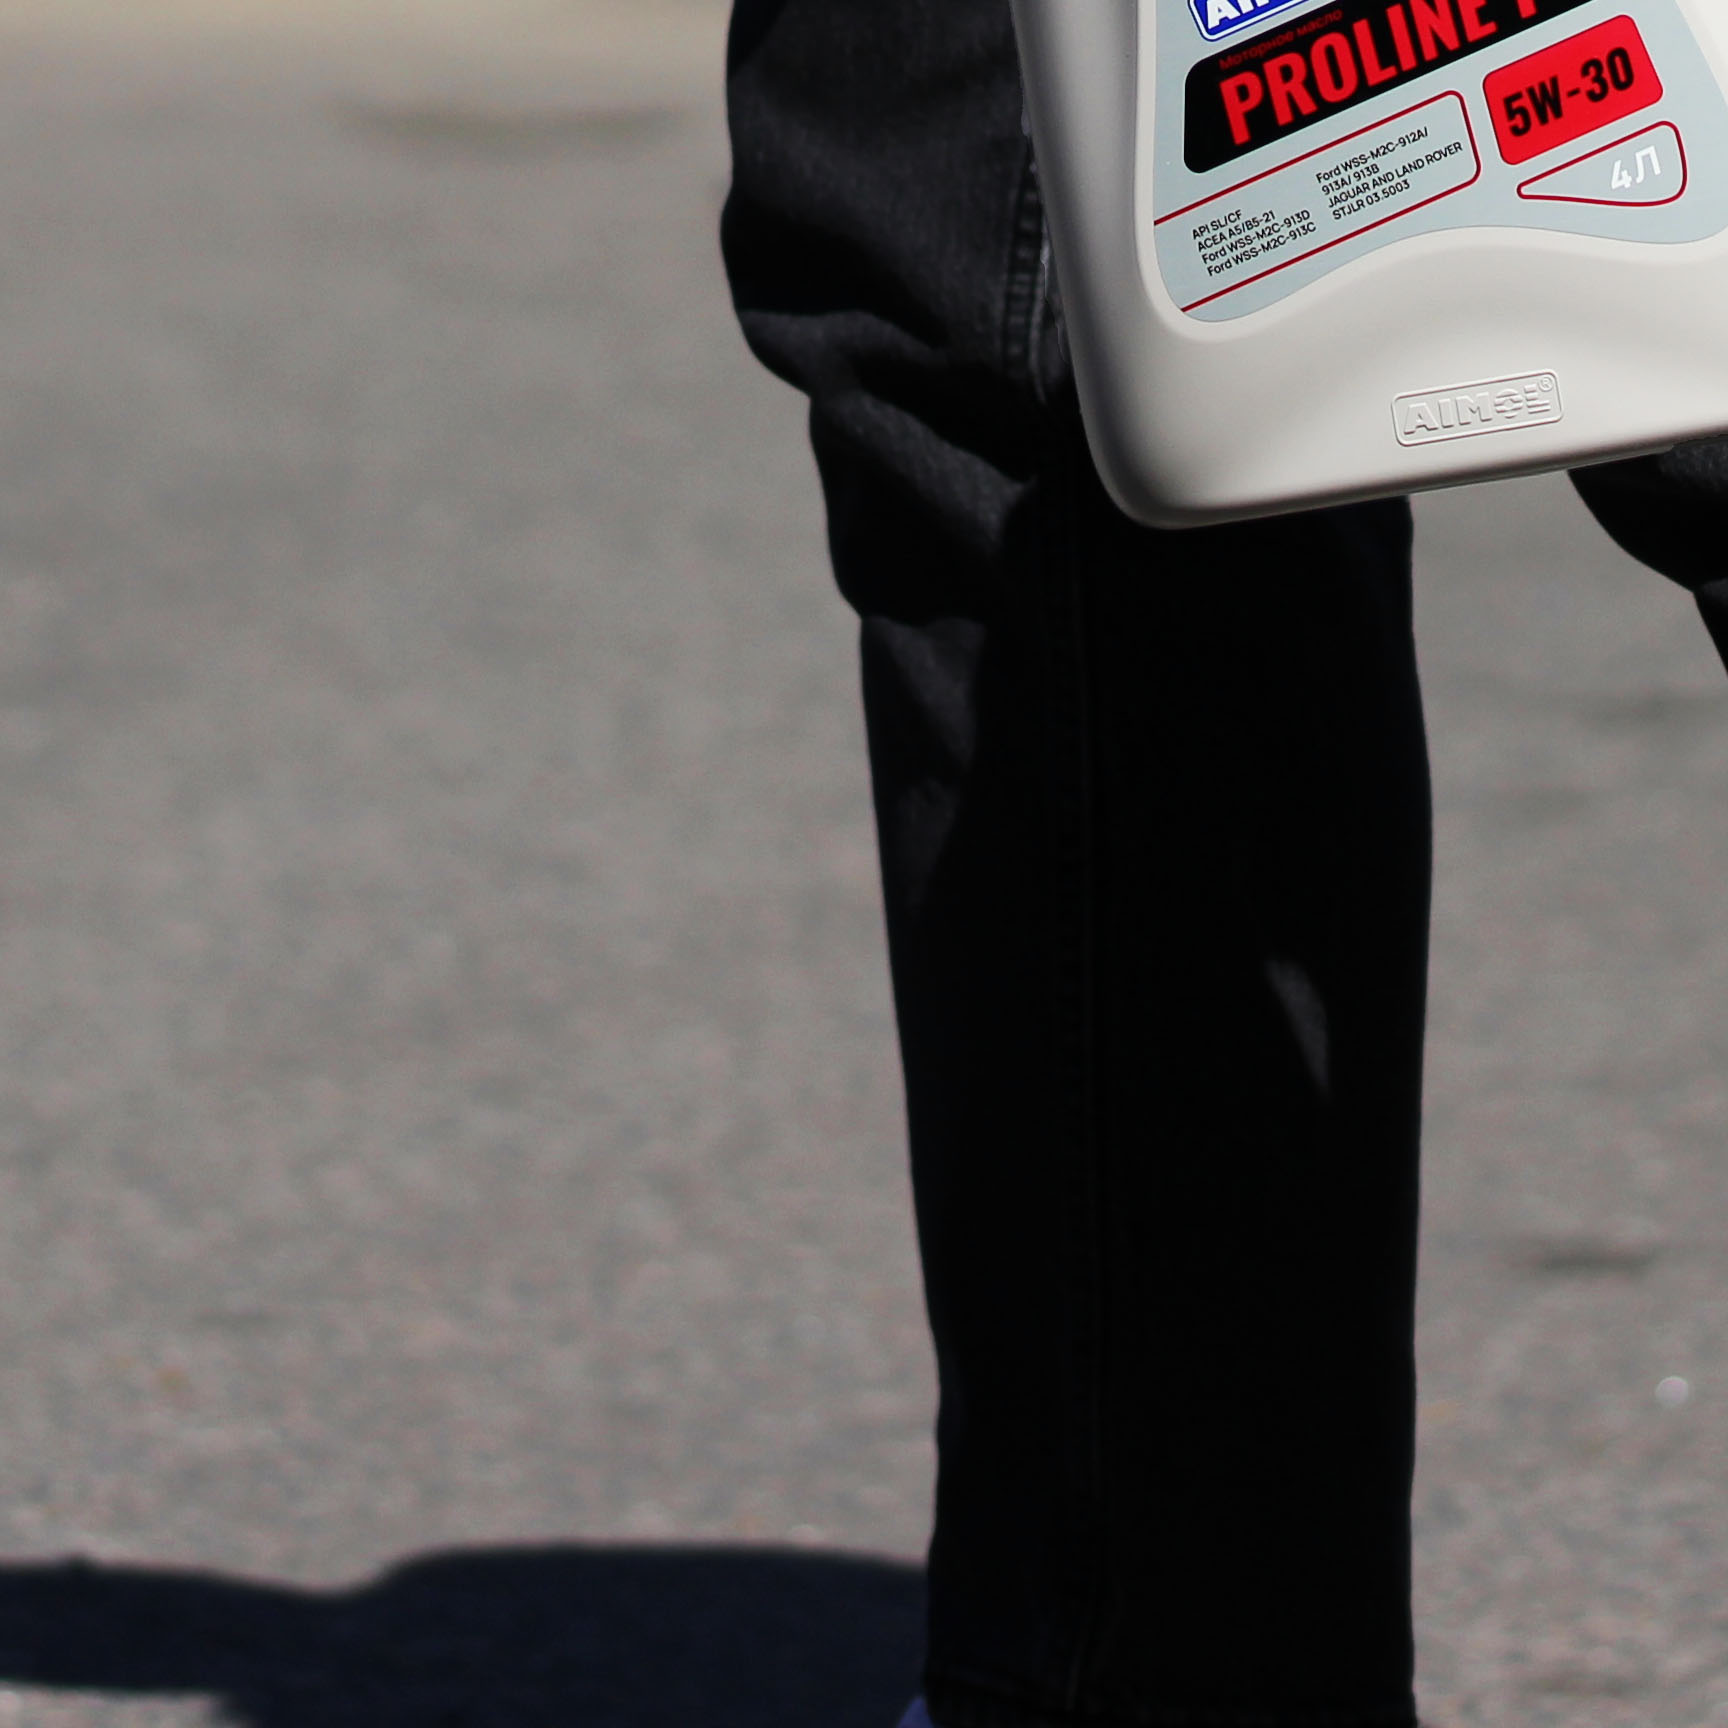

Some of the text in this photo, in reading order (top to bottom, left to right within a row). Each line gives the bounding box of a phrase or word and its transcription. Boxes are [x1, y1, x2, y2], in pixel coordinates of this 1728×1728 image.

[1218, 8, 1344, 70] Моторное масло
[1502, 46, 1635, 138] 5W-30
[1315, 126, 1429, 184] Ford WSS-M2C-912A/
[1321, 163, 1380, 196] 913A/ 913B
[1328, 141, 1463, 208] JAGUAR AND LAND ROVER
[1191, 209, 1242, 240] API SL/CF
[1332, 179, 1411, 220] STJLR 03.5003
[1197, 210, 1276, 252] ACEA A5/B5-21
[1201, 209, 1311, 265] Ford WSS-M2C-913D
[1206, 222, 1317, 277] Ford WSS-M2C-913C
[1403, 382, 1552, 436] AIMOL
